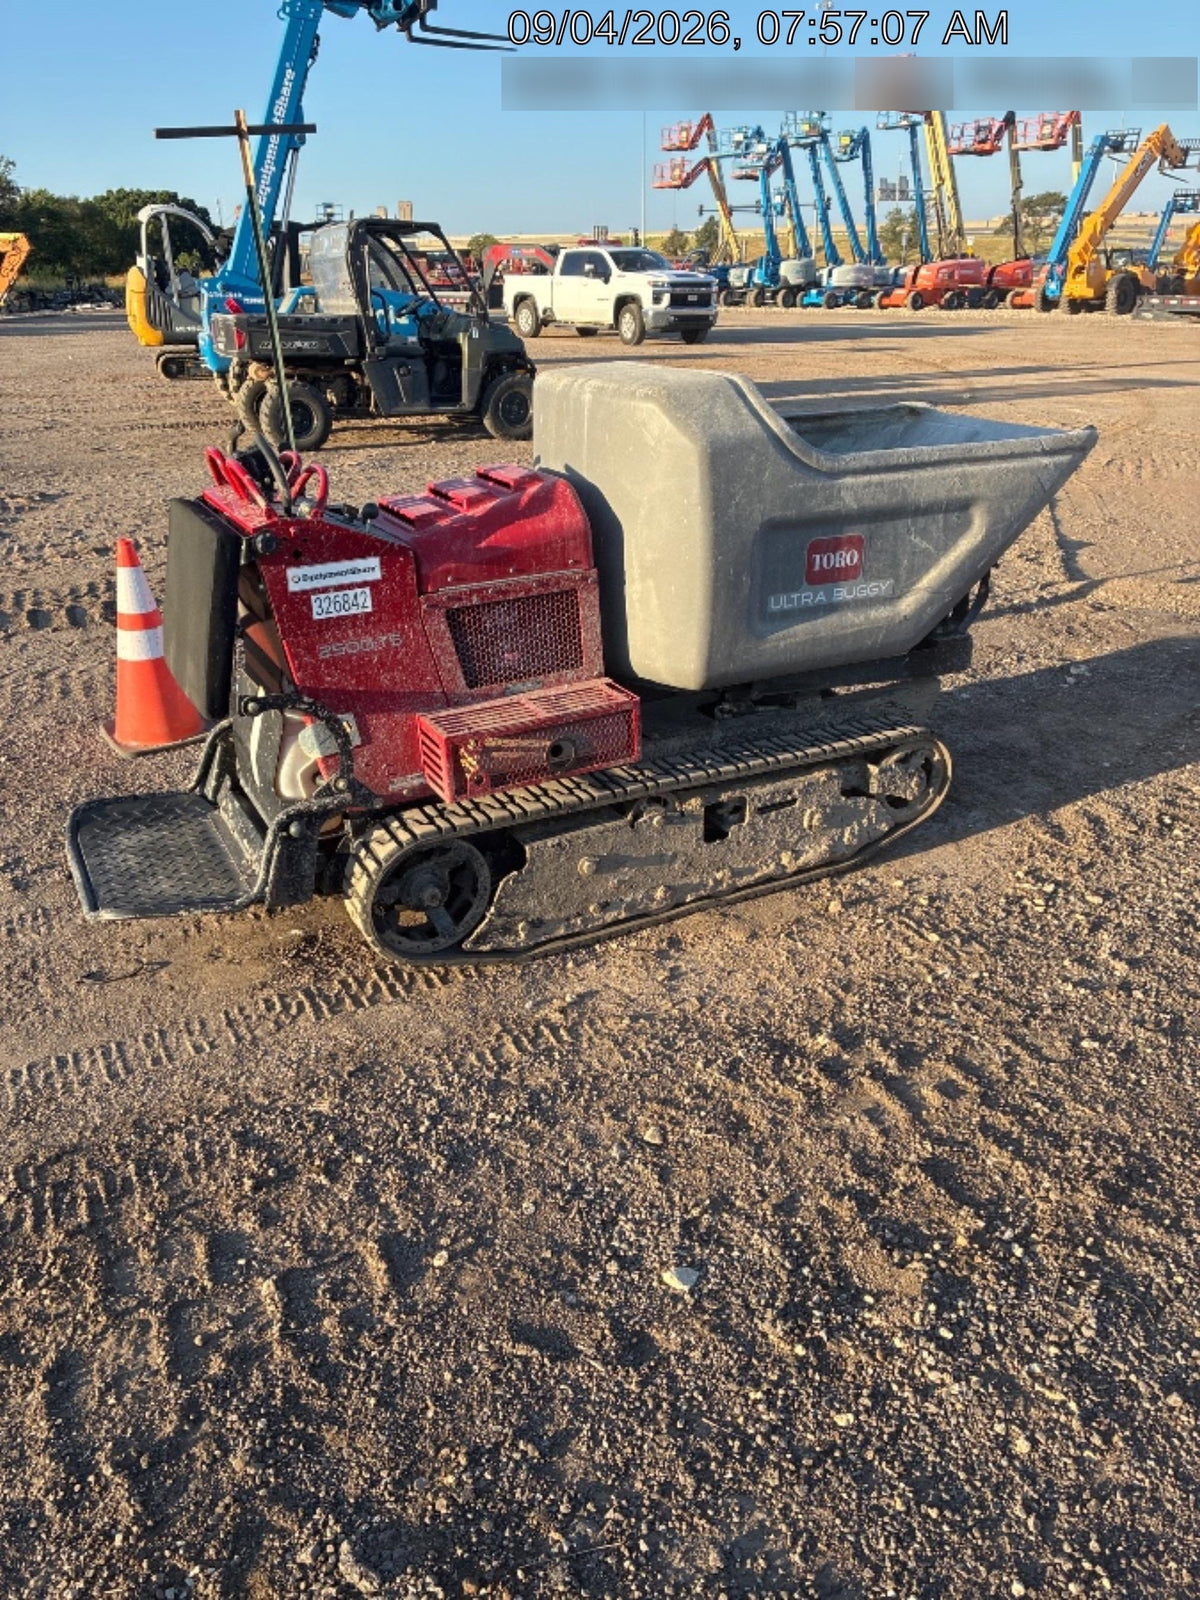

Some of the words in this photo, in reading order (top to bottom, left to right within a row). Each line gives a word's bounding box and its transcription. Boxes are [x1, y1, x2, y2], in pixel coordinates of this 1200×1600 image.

[258, 68, 296, 206] EquipmetShare
[812, 549, 860, 571] TORO
[314, 590, 369, 616] 326842
[771, 592, 827, 609] ULTRA
[833, 581, 891, 600] BUGGY
